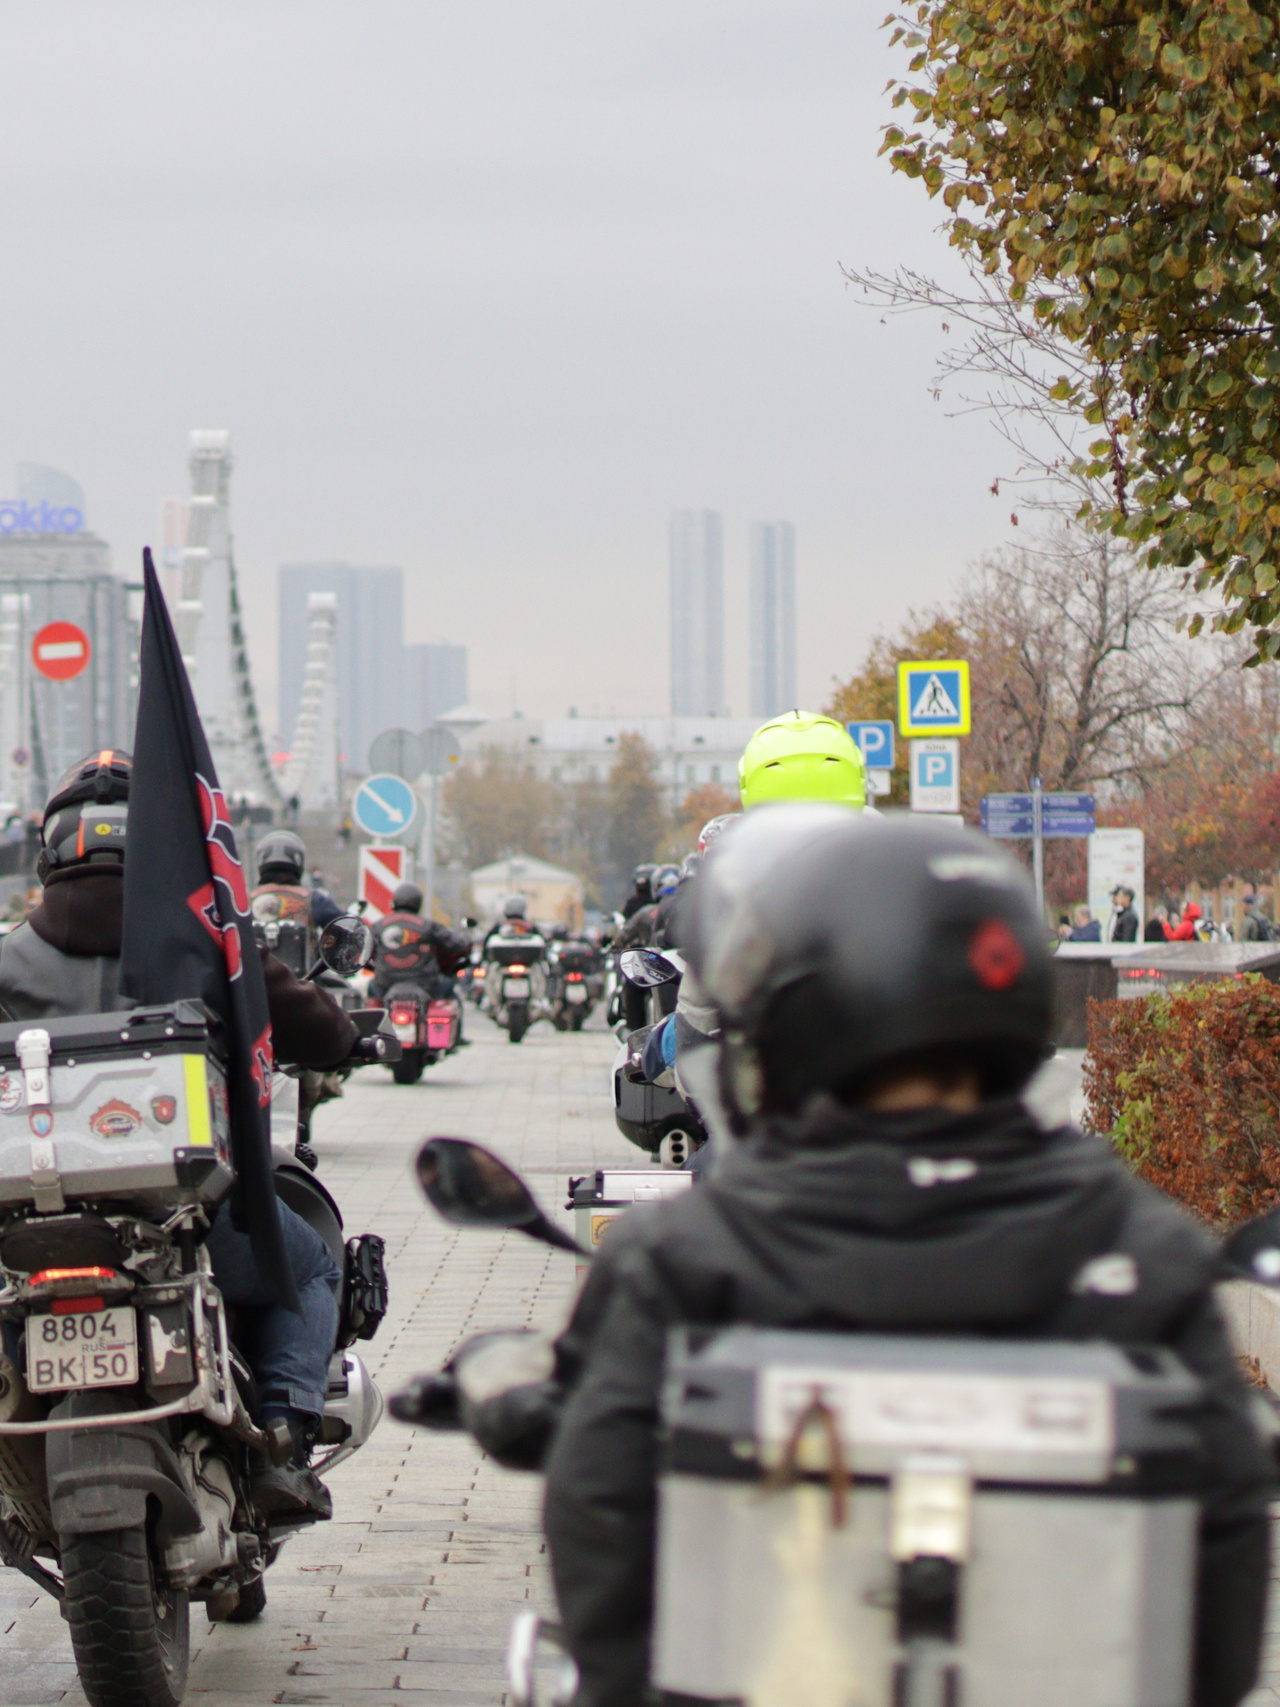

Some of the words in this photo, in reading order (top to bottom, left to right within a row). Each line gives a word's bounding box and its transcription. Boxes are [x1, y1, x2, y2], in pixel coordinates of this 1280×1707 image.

[42, 1312, 117, 1343] 8804
[82, 1343, 107, 1352] RUS
[93, 1353, 128, 1379] 50
